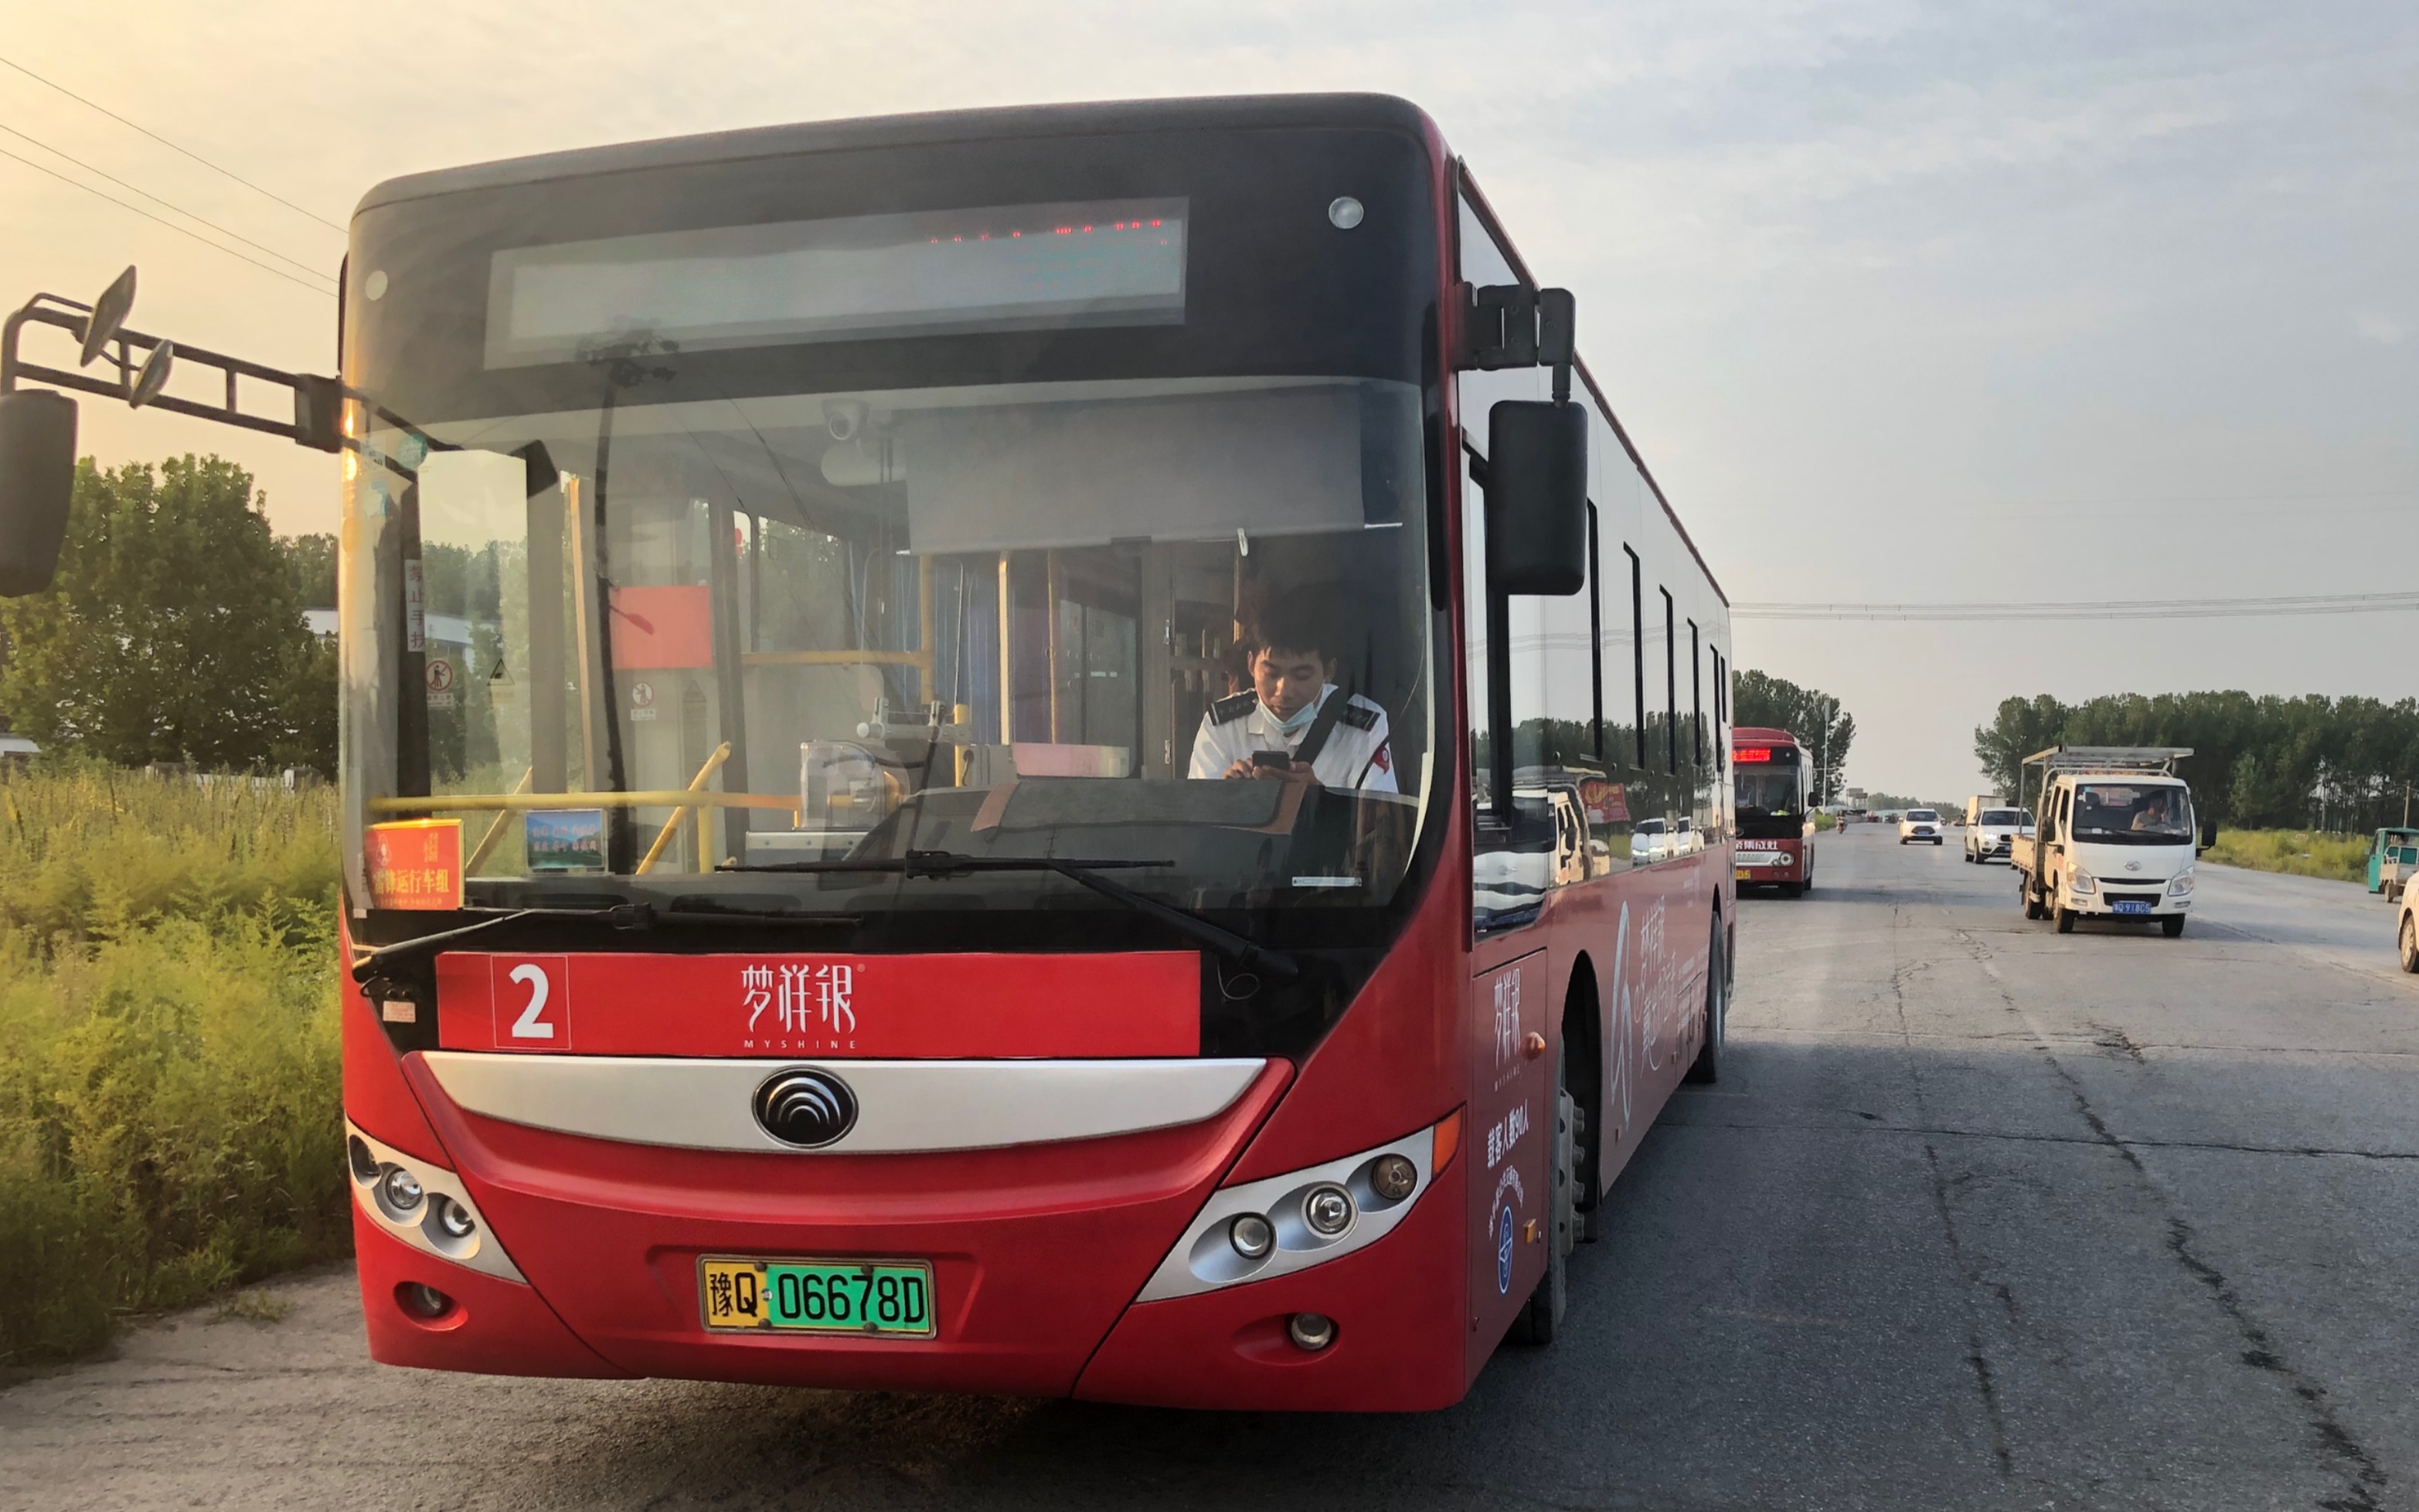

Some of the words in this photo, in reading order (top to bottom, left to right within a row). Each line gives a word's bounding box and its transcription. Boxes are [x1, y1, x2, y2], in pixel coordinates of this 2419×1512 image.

[373, 868, 450, 895] 雷锋运行车组
[509, 963, 554, 1039] 2
[741, 963, 856, 1034] 梦祥银
[743, 1040, 856, 1049] MYSHINE
